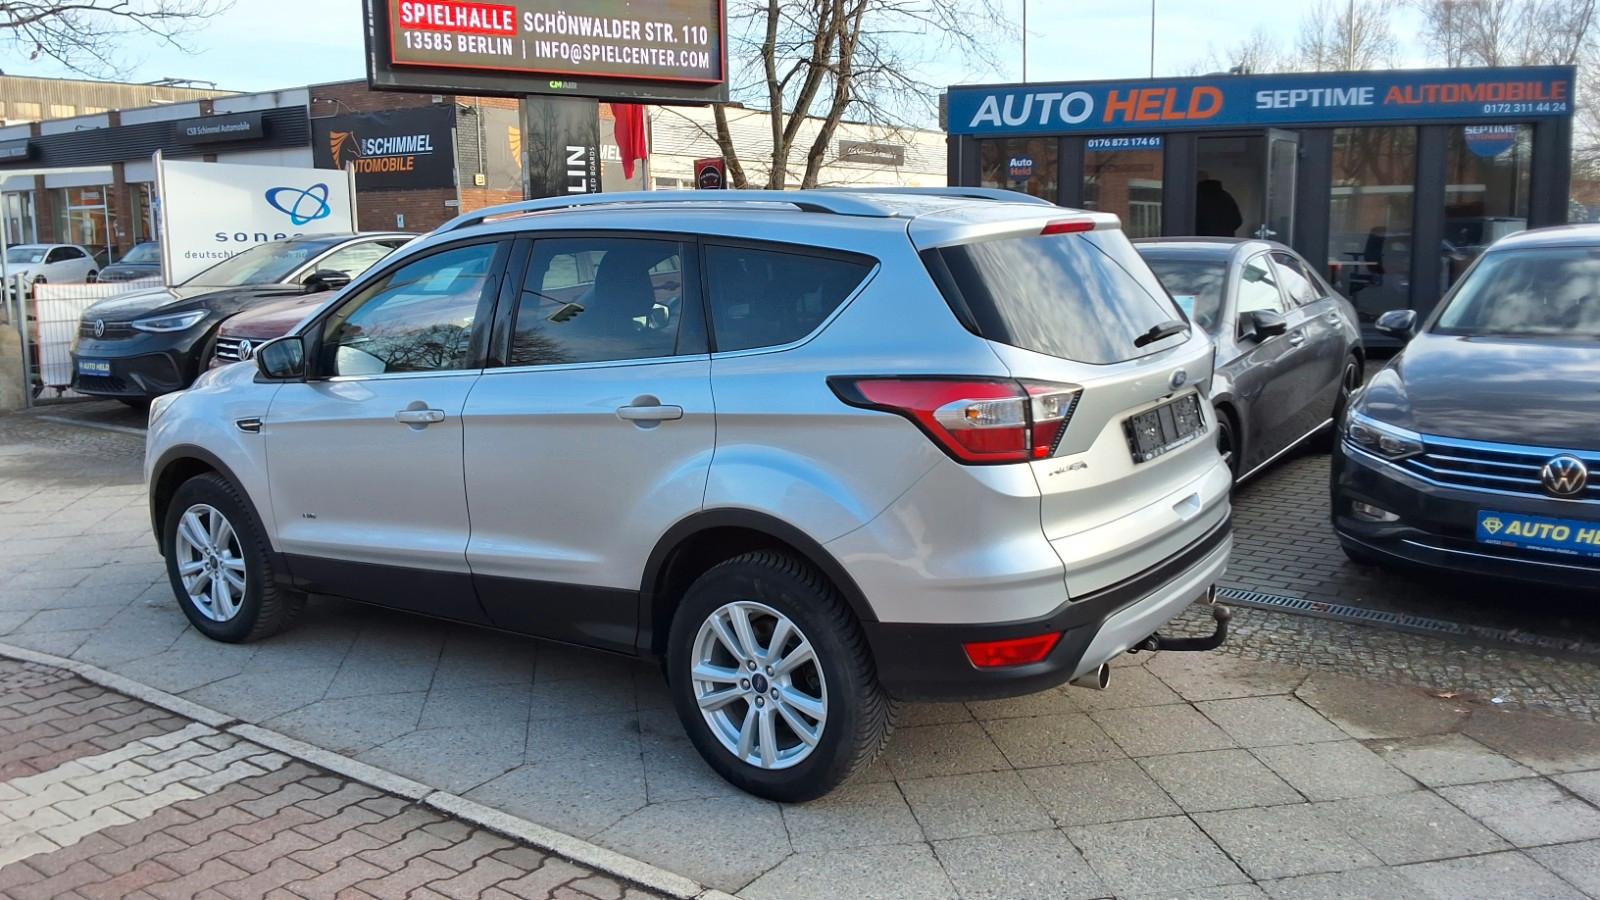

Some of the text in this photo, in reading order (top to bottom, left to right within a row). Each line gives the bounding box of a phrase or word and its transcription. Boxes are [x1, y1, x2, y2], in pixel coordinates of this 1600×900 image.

[401, 1, 708, 45] SPIELHALLE SCHÖNWALDER STR. 110
[403, 31, 453, 52] 13585
[457, 34, 513, 56] BERLIN
[535, 40, 710, 69] INFO@SPIELCENTER.COM
[1256, 81, 1567, 109] SEPTIME AUTOMOBILE
[968, 86, 1224, 128] AUTO HELD
[1484, 102, 1567, 113] 0172 311 44 24
[1464, 126, 1516, 135] SEPTIME
[367, 135, 433, 155] SCHIMMEL
[1088, 137, 1160, 148] 0176 873 174 61
[353, 157, 414, 173] UTOMOBILE
[589, 146, 597, 176] BOARDS
[1010, 158, 1033, 168] Auto
[1505, 521, 1570, 541] AUTO
